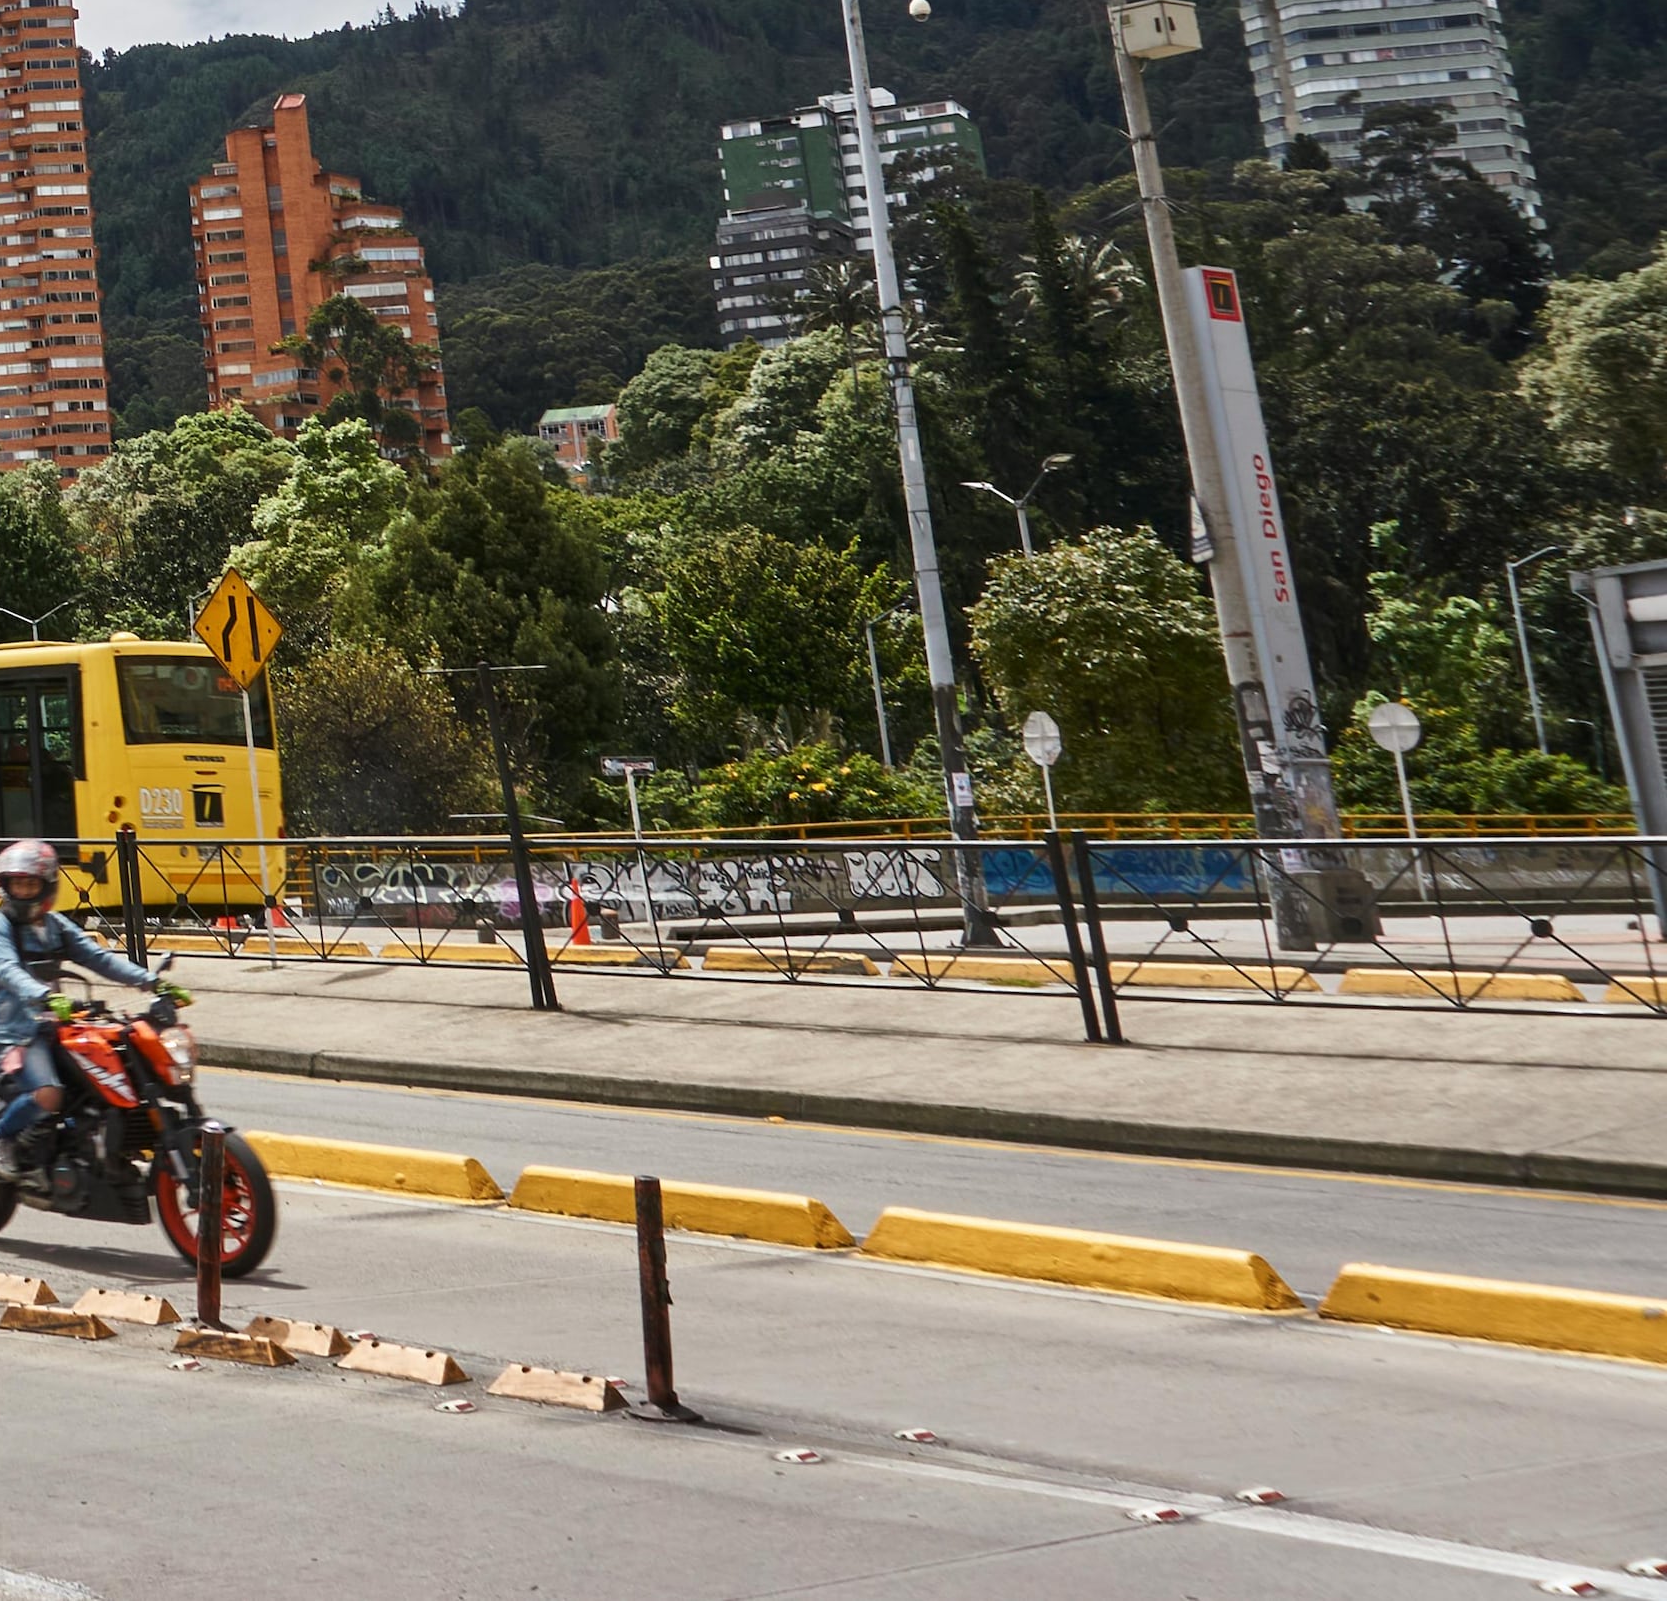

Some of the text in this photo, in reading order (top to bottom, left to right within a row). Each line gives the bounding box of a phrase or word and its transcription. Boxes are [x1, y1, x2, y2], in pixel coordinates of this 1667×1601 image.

[1253, 454, 1290, 603] San Diego
[140, 787, 183, 815] D230
